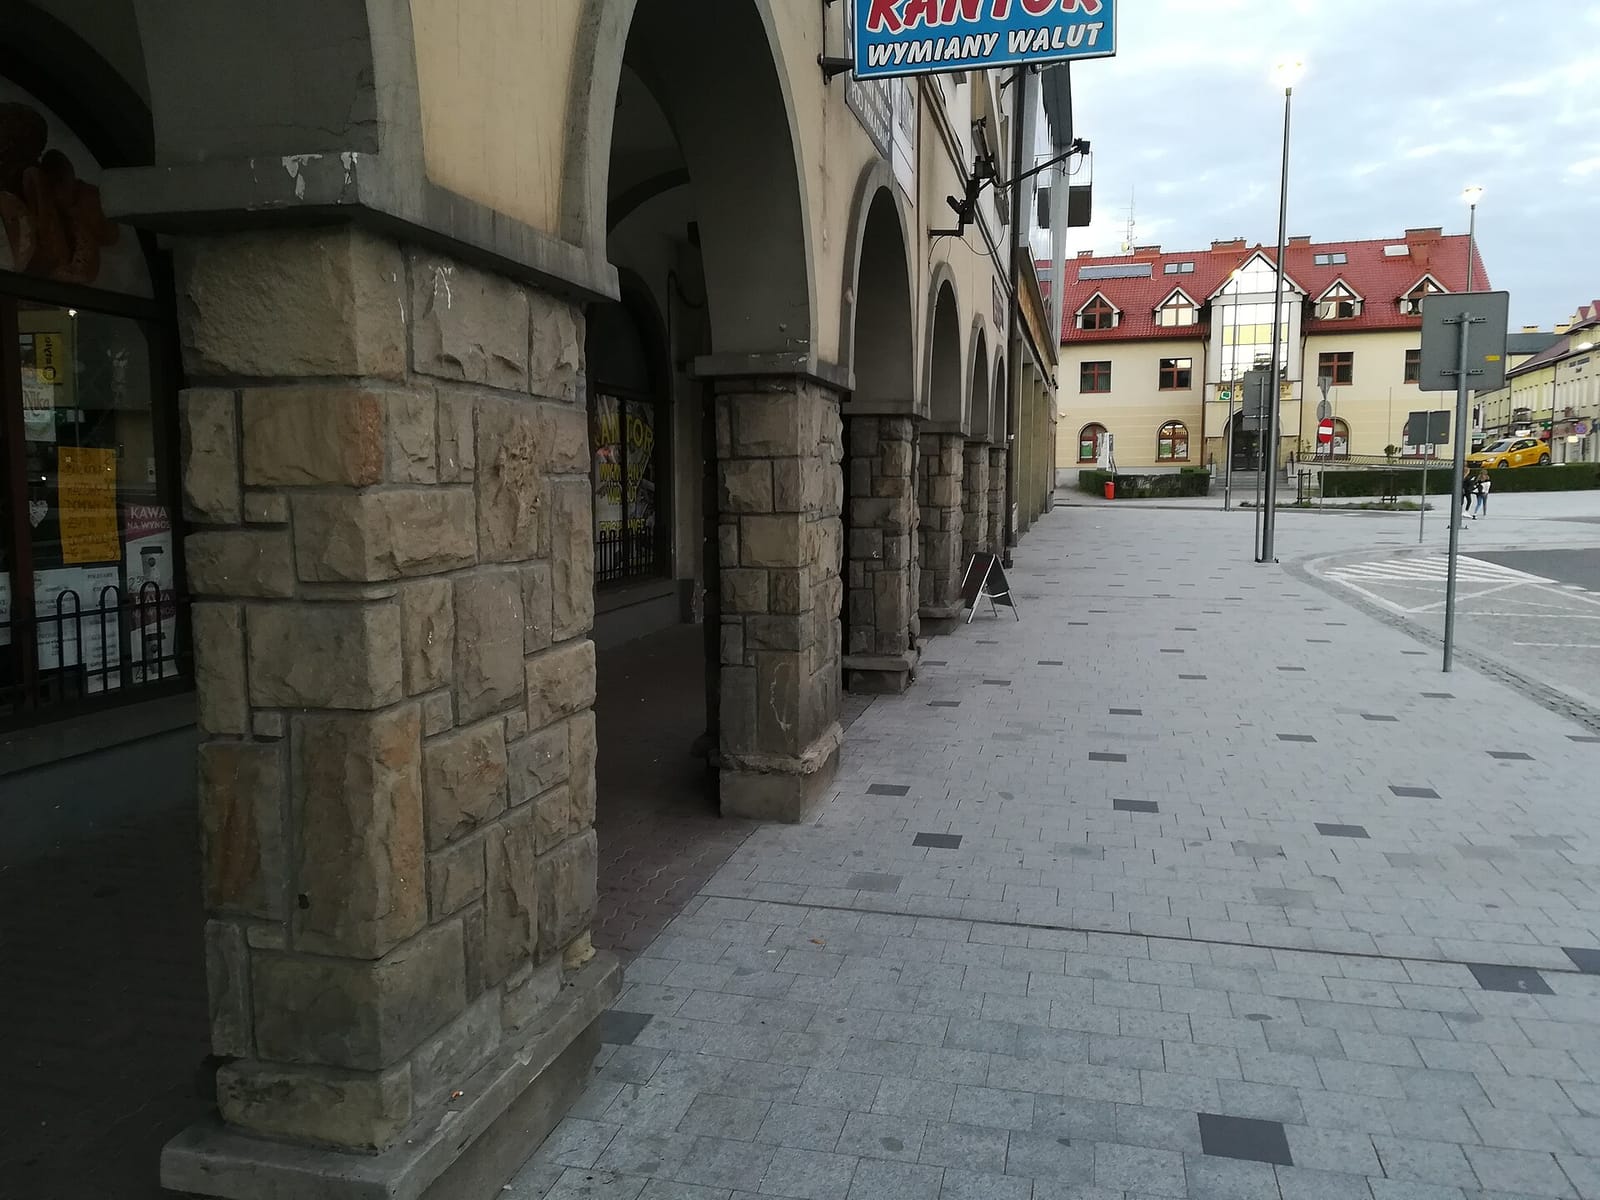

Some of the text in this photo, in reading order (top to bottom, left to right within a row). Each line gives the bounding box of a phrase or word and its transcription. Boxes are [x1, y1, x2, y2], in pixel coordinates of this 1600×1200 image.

[866, 0, 1103, 34] KAN
[867, 22, 1103, 67] WYMIANY WALUT
[599, 463, 643, 480] WYMANY
[608, 486, 637, 504] WAUT
[131, 505, 168, 519] KAWA
